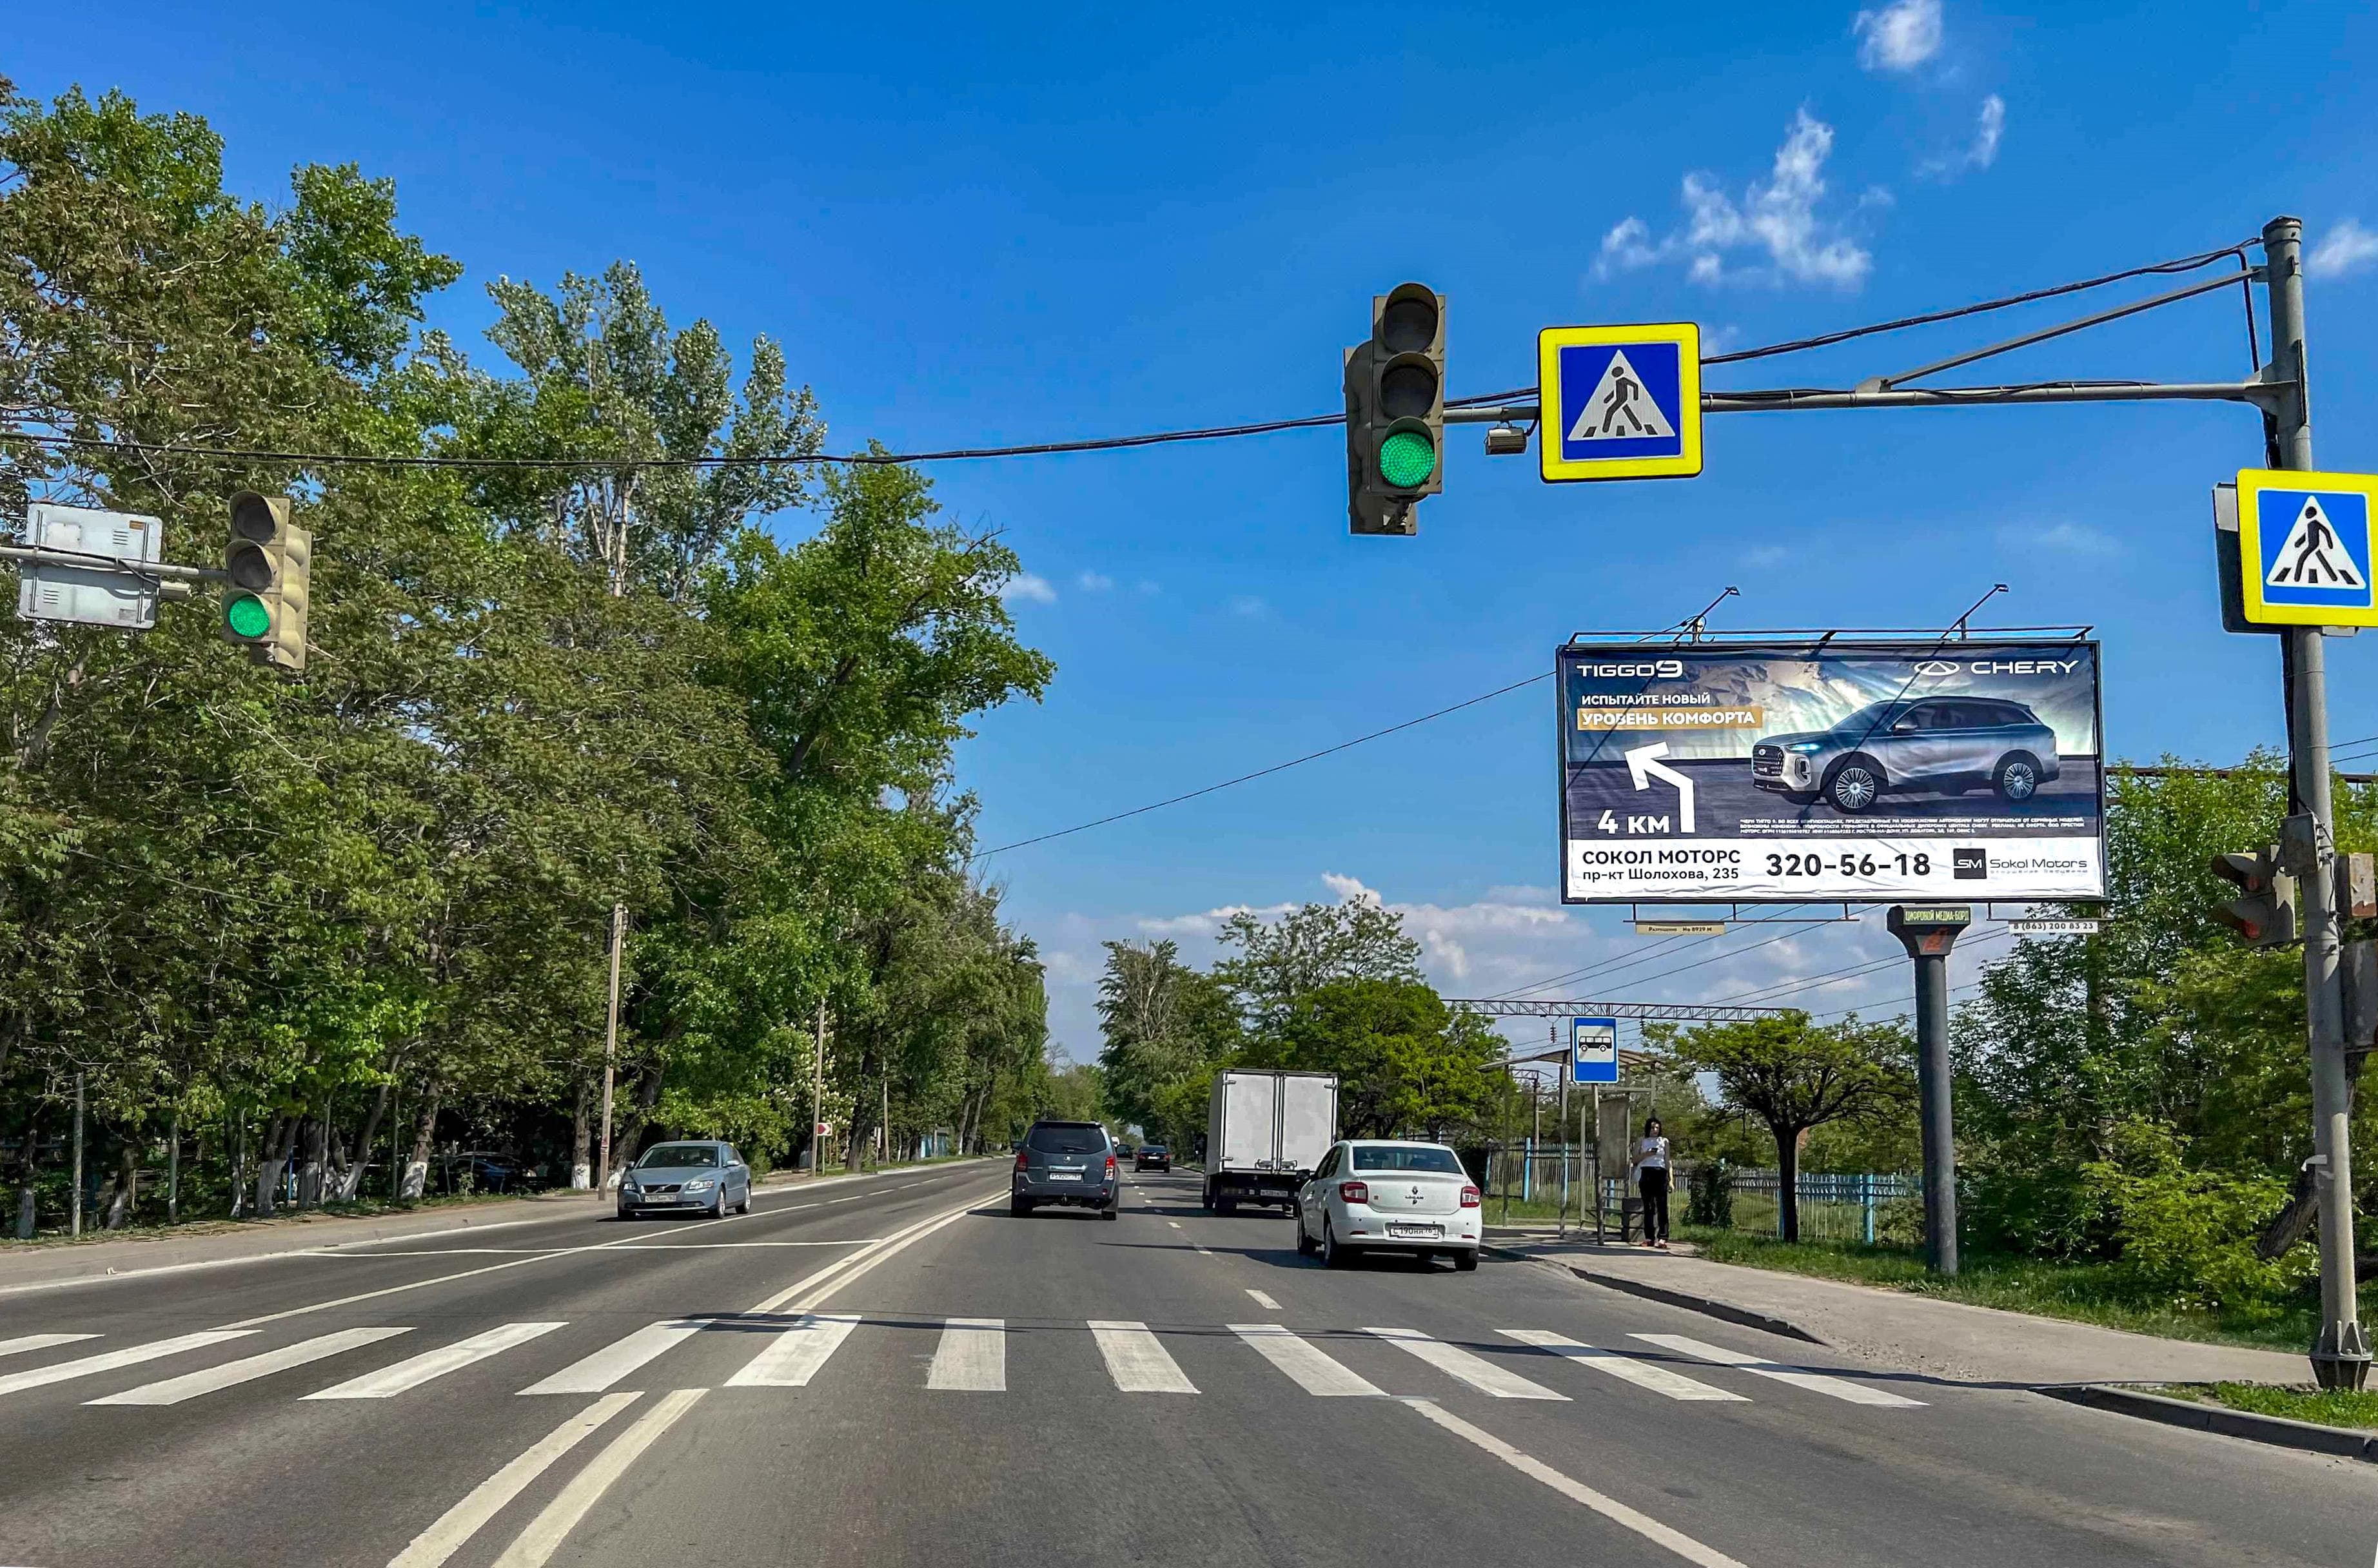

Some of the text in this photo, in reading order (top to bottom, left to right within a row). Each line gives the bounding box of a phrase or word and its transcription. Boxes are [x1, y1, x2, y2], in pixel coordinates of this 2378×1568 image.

[1970, 660, 2079, 674] CHERY
[1582, 692, 1711, 705] ИСПЫТАЙТЕ НОВЫЙ
[1582, 711, 1755, 726] УРОВЕНЬ КОМФОРТА
[1597, 809, 1618, 834] 4
[1582, 850, 1741, 865] СОКОЛ МОТОРС
[1765, 853, 1931, 876] 320-56-18
[1954, 859, 1983, 868] SM
[1990, 858, 2087, 868] Sokol Motors
[1583, 867, 1739, 883] пр-кт Шолохова, 235
[1905, 910, 1969, 921] ЦИФРОВОЙ МЕДИА-БОРД
[2021, 922, 2047, 931] (863)
